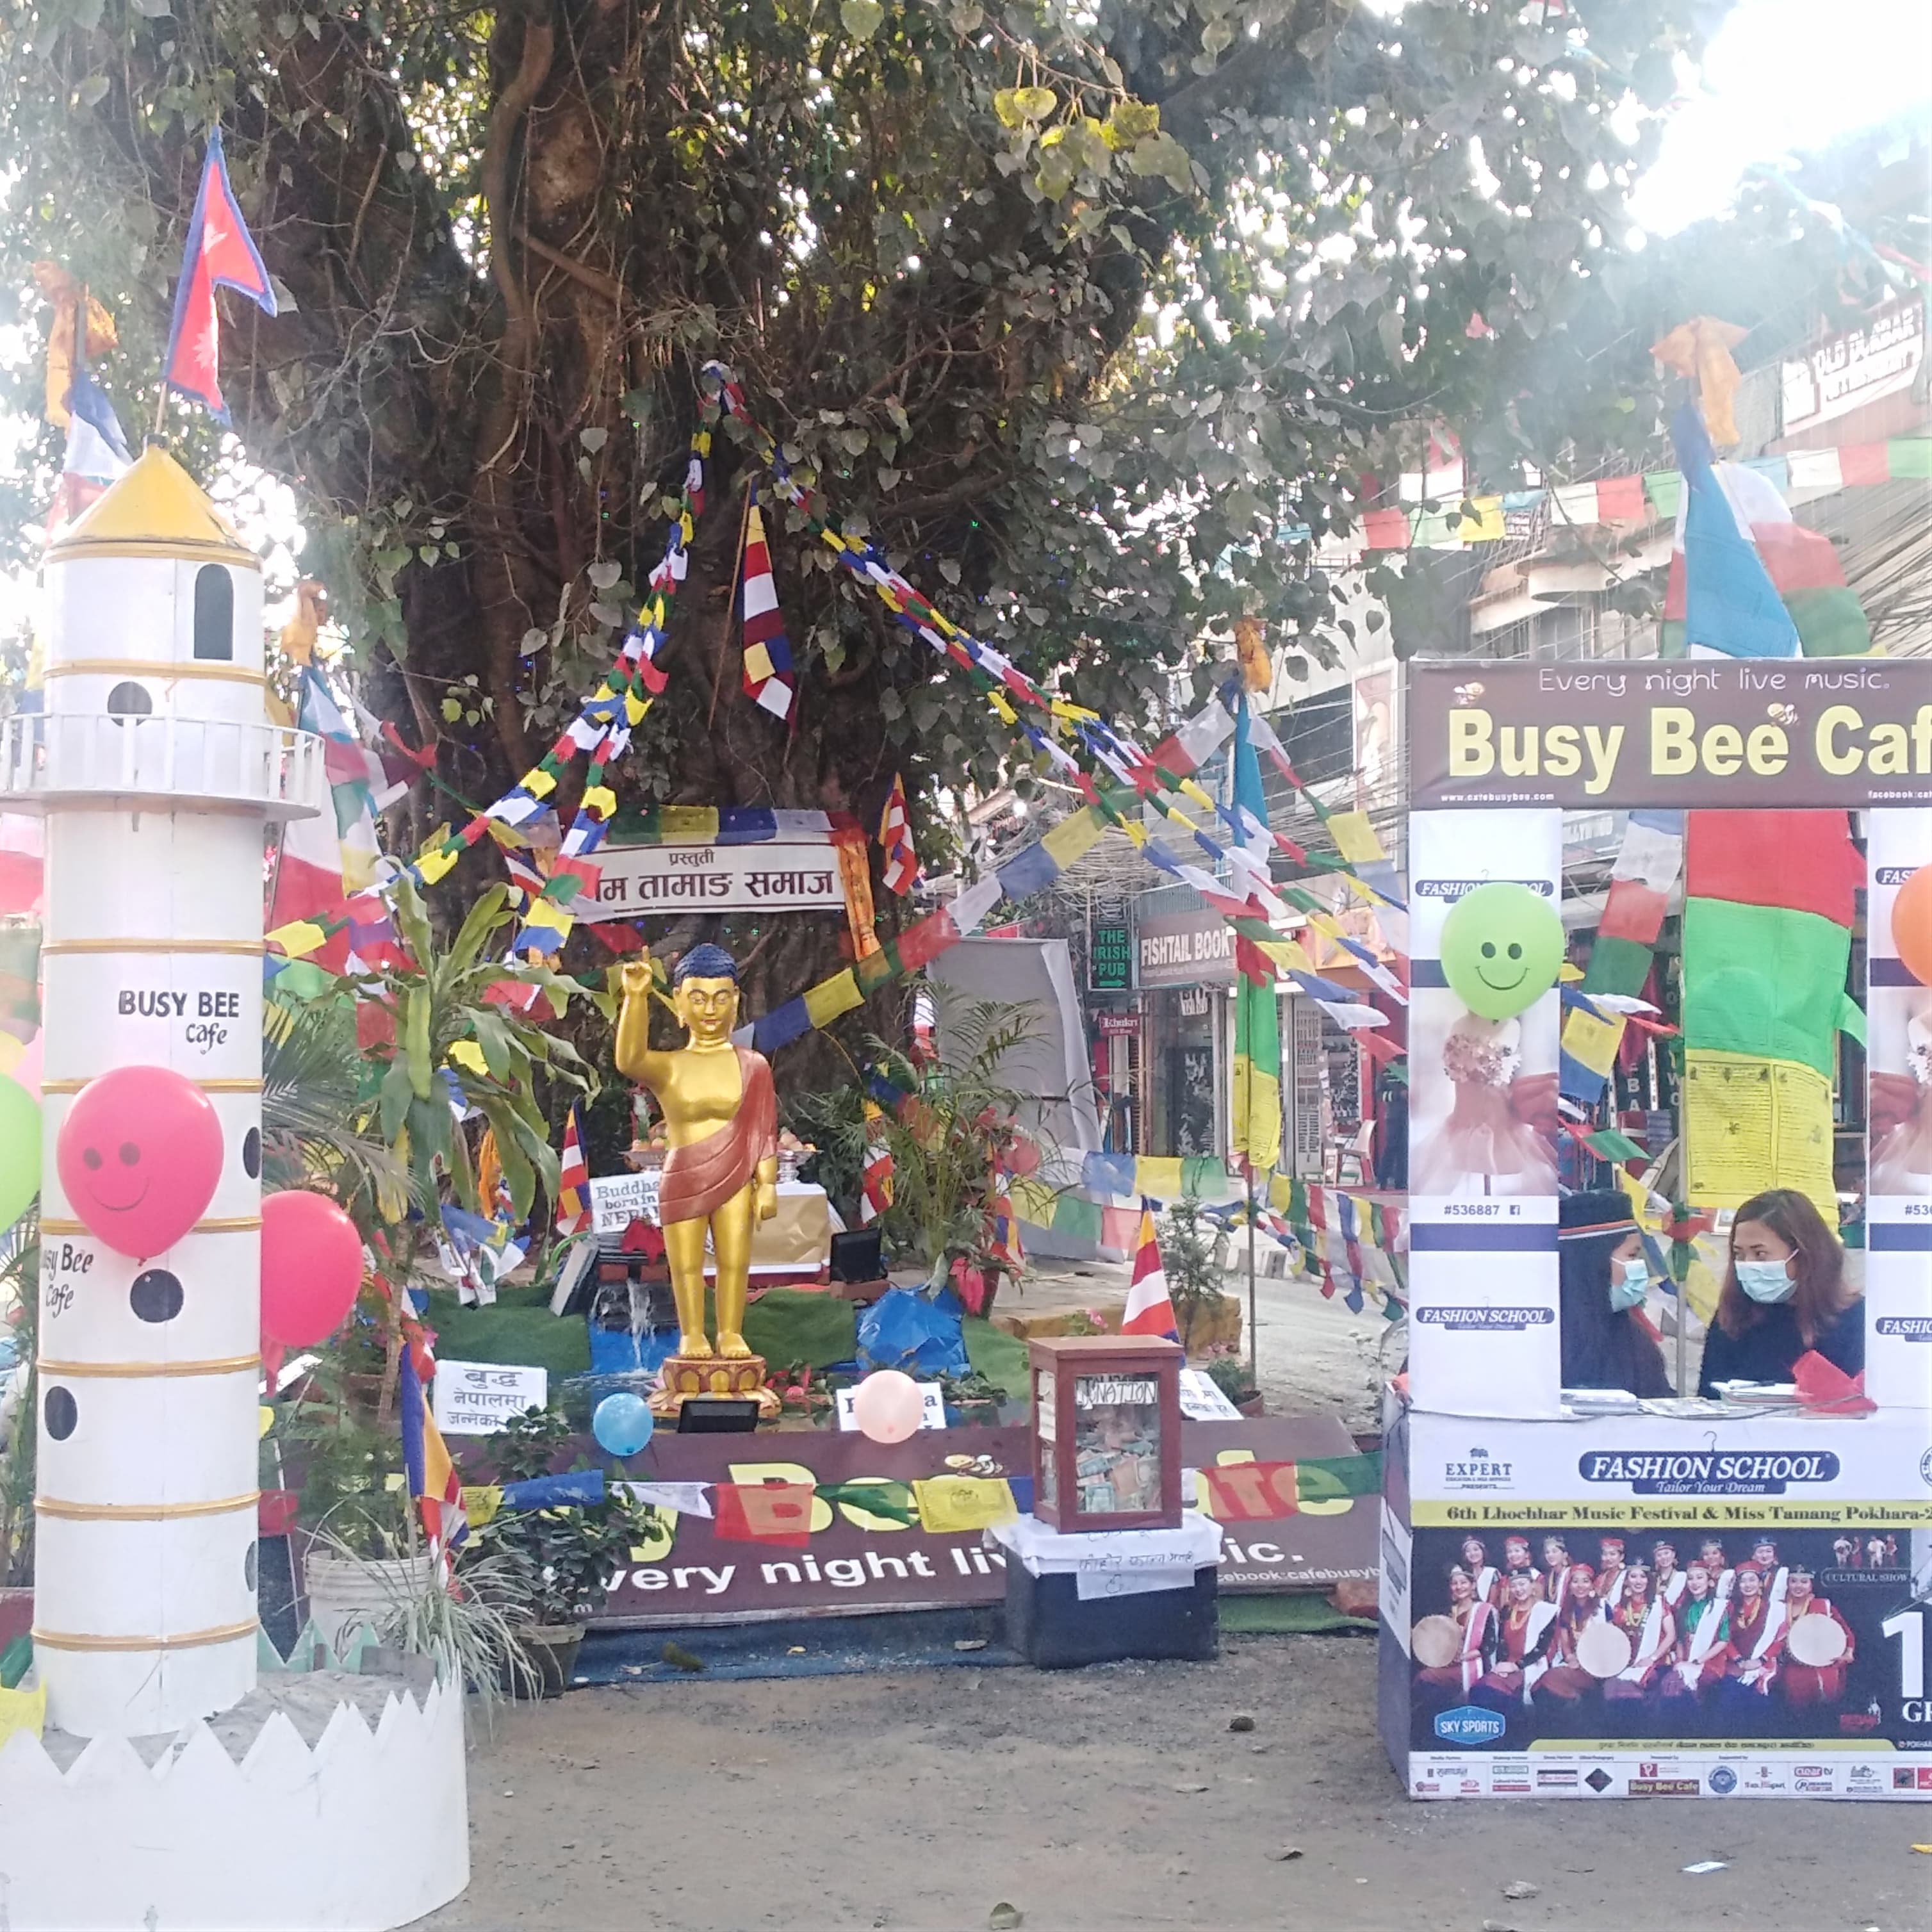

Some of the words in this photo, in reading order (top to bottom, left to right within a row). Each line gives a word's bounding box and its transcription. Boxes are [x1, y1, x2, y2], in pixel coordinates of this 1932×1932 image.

[1539, 668, 1627, 696] Every
[1645, 668, 1722, 696] night
[1739, 668, 1786, 691] live
[1805, 669, 1891, 691] music.
[1448, 708, 1625, 794] Busy
[1651, 707, 1789, 775] Bee
[1815, 705, 1932, 775] Caf
[1881, 869, 1913, 883] FAS
[744, 871, 834, 897] समाज
[1421, 882, 1482, 895] FASHIO
[1098, 930, 1126, 943] THE
[1094, 946, 1131, 960] IRISH
[1141, 933, 1192, 967] FISHTAIL
[1098, 963, 1126, 976] PUB
[118, 990, 188, 1018] BUSY
[197, 992, 240, 1019] BEE
[605, 1198, 639, 1209] born
[643, 1194, 656, 1205] in
[1444, 1205, 1500, 1215] #536887
[61, 1243, 94, 1273] Bee
[1422, 1309, 1489, 1323] FASHION
[1489, 1309, 1548, 1323] SCHOOL
[464, 1368, 523, 1389] बुद्ध
[454, 1388, 527, 1408] नेपालमा
[1445, 1463, 1512, 1476] EXPERT
[1591, 1456, 1713, 1479] FASHION
[1715, 1456, 1825, 1479] SCHOOL
[1656, 1481, 1690, 1493] Tailor
[1695, 1481, 1723, 1493] Your
[1726, 1481, 1765, 1493] Dream
[1447, 1506, 1477, 1520] 6th
[1482, 1506, 1568, 1520] Lhochhar
[1573, 1507, 1626, 1520] Music
[1631, 1506, 1698, 1520] Festival
[1701, 1507, 1719, 1519] &
[1724, 1506, 1765, 1519] Miss
[1769, 1506, 1840, 1522] Tamang
[1217, 1538, 1305, 1564] ic.
[577, 1564, 736, 1594] very
[760, 1550, 936, 1587] night
[951, 1547, 1007, 1576] liv
[1827, 1573, 1878, 1582] CULTURAL
[1879, 1573, 1908, 1582] SHOW
[1441, 1721, 1461, 1733] SKY
[1462, 1720, 1500, 1734] SPORTS
[1630, 1782, 1653, 1792] Busy
[1656, 1782, 1674, 1791] Bee
